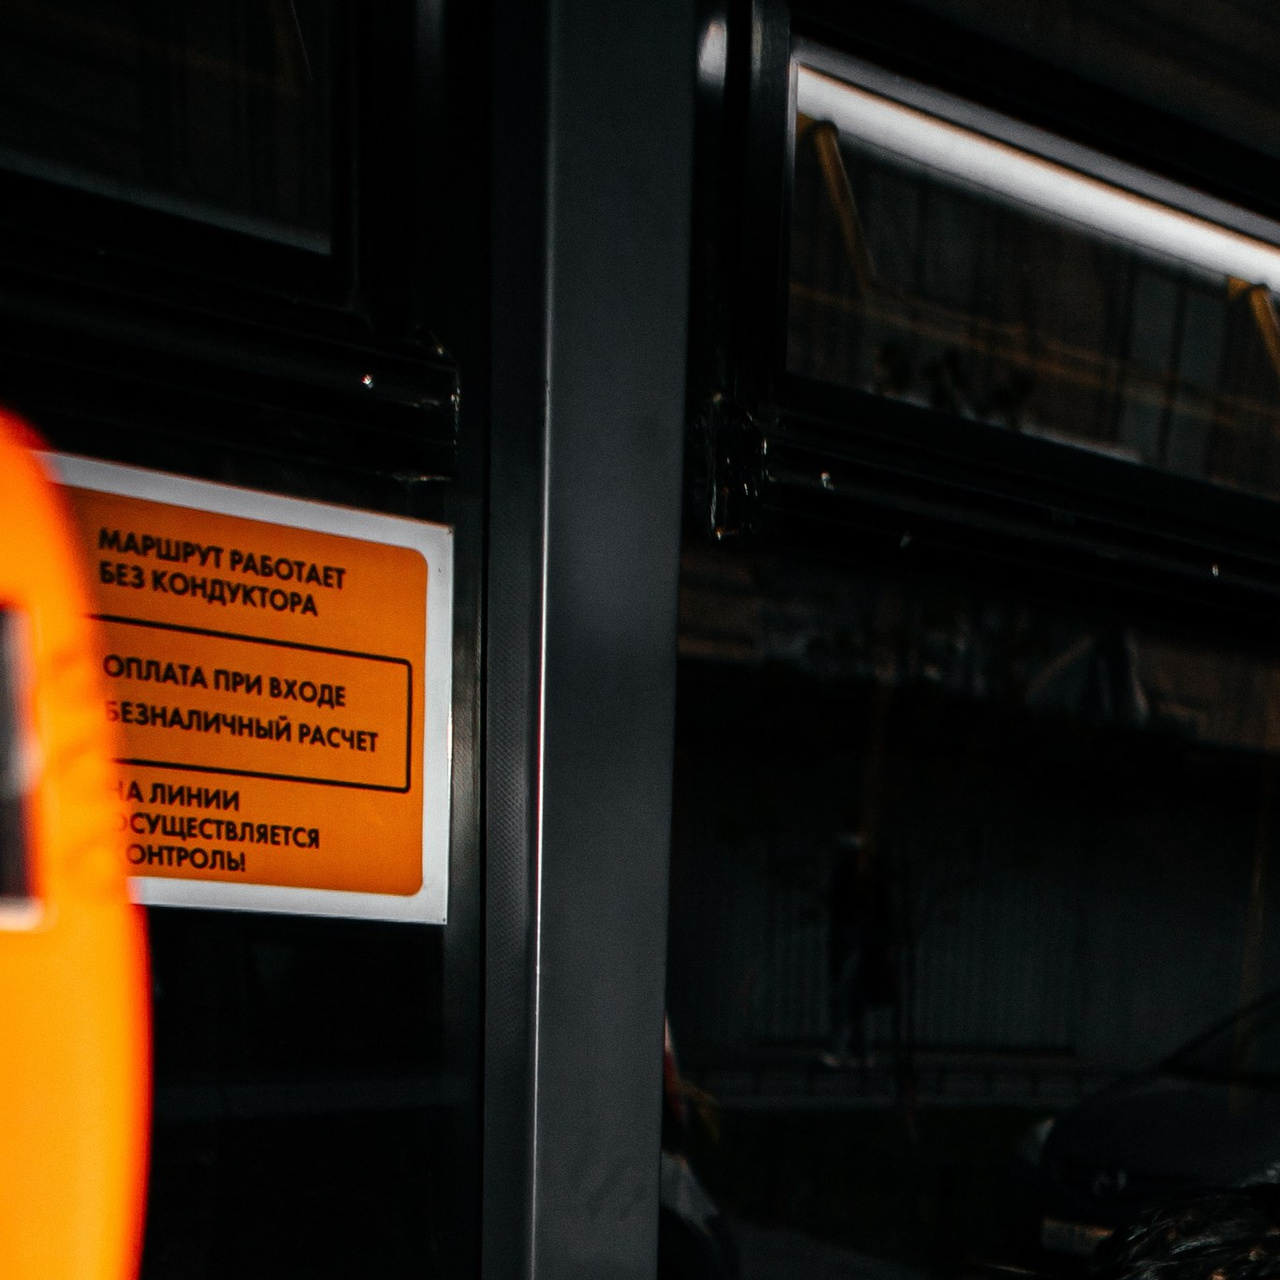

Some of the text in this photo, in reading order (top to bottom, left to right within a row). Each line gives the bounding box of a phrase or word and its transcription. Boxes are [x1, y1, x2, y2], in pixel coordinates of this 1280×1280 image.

[98, 527, 346, 590] МАРШРУТ РАБОТАЕТ
[99, 560, 318, 616] БЕЗ КОНДУКТОРА
[103, 654, 346, 709] ОПЛАТА ПРИ ВХОДЕ
[298, 724, 379, 752] РАСЧЕТ
[148, 782, 240, 812] ЛИНИИ
[126, 843, 246, 872] ОНТРОЛЬ!
